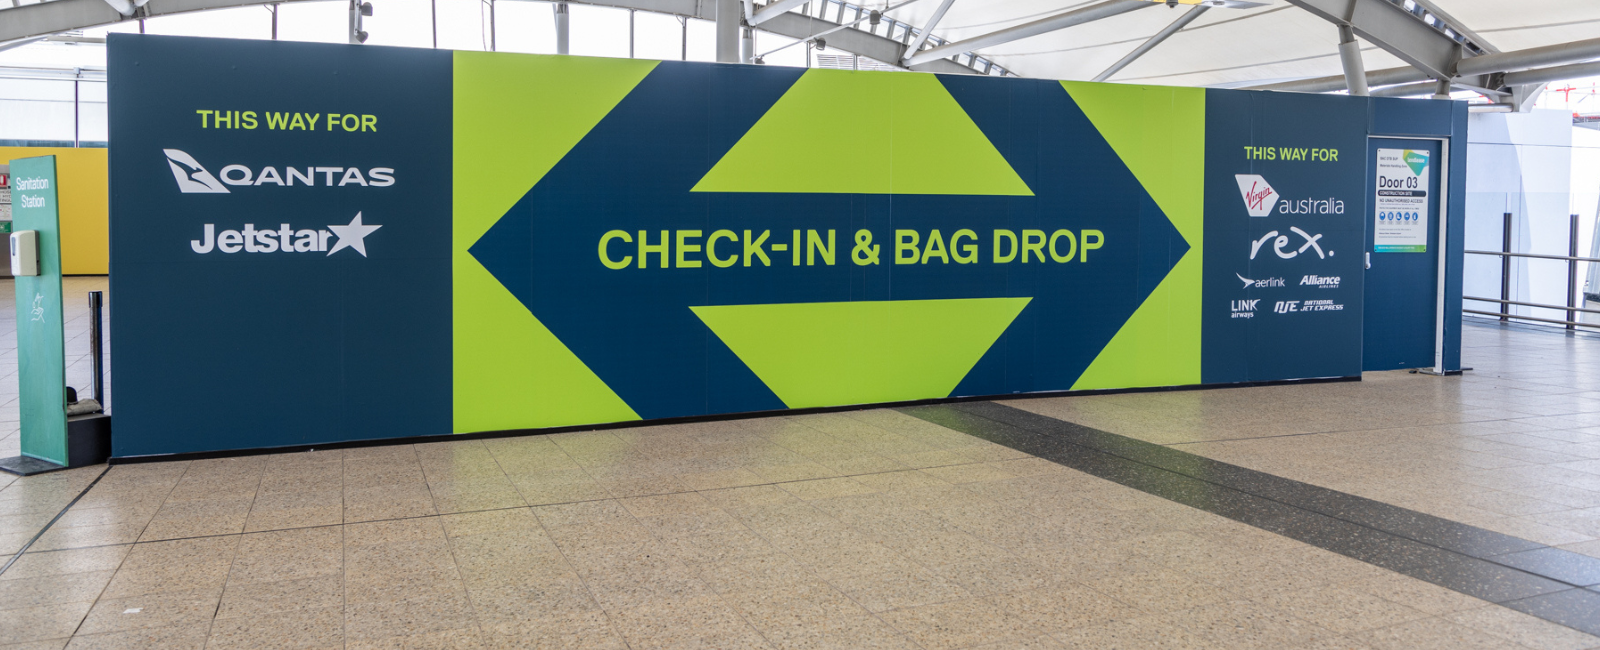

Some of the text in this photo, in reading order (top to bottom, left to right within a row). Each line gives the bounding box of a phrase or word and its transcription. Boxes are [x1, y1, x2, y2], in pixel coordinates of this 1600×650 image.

[196, 110, 378, 132] THIS WAY FOR
[1243, 146, 1339, 162] THIS WAY FOR
[219, 164, 396, 187] QANTAS
[1380, 176, 1418, 189] Door 03
[16, 176, 49, 191] Sanitation
[21, 194, 46, 208] Station
[1246, 181, 1272, 210] Virgin
[1279, 197, 1345, 214] australia
[190, 223, 334, 254] Jetstar
[597, 228, 1106, 271] CHECK-IN & BAG DROP
[1255, 277, 1285, 287] aerlink
[1299, 275, 1341, 286] Alliance
[1231, 299, 1261, 312] LINK
[1231, 311, 1254, 319] airways
